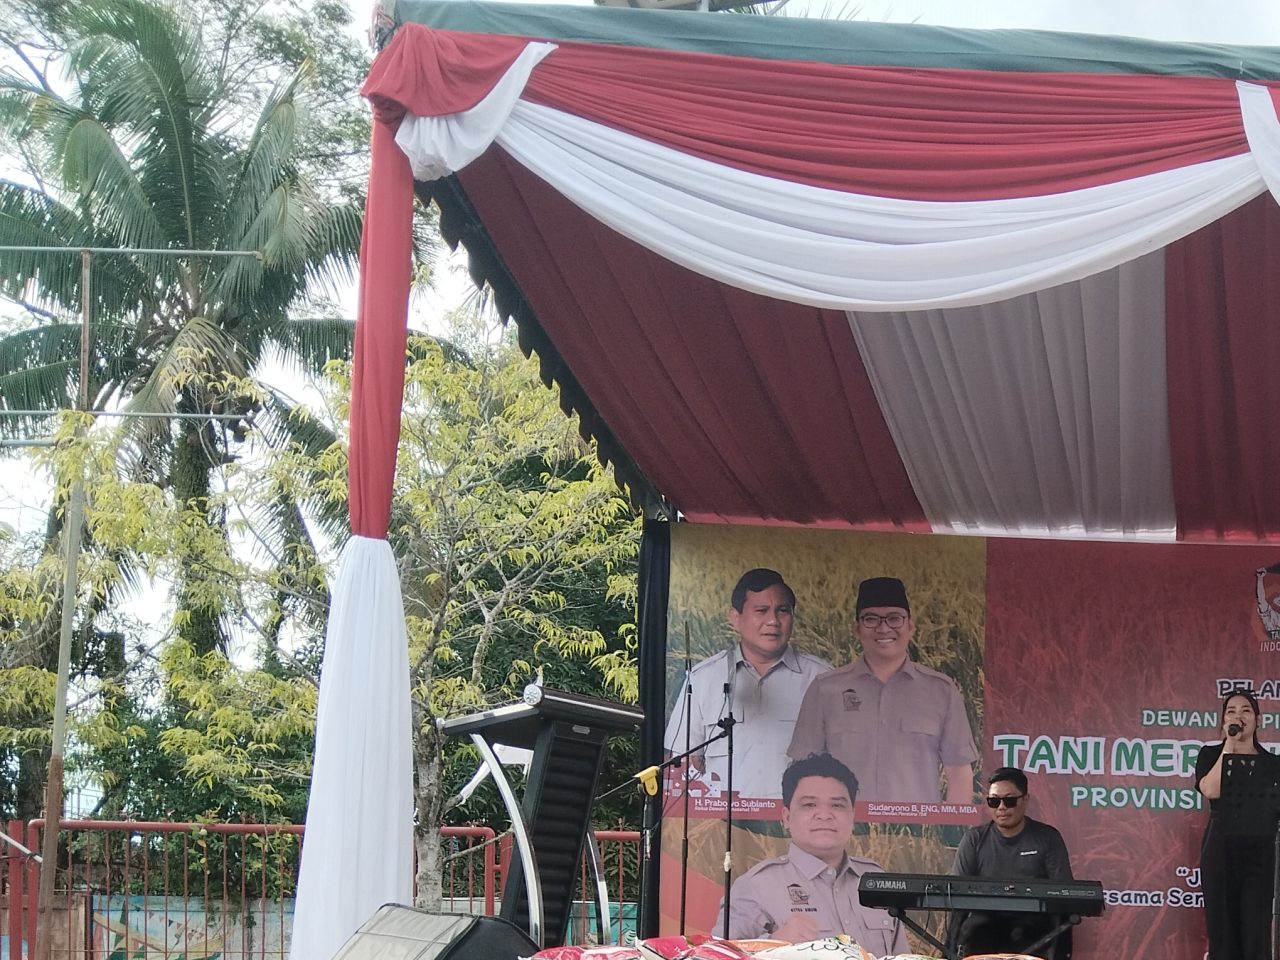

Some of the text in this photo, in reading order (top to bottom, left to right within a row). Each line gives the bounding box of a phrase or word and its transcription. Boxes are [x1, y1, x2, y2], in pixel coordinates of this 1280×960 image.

[1142, 709, 1217, 728] DEWAN
[994, 735, 1105, 775] TANI
[1071, 785, 1202, 810] PROVINSI
[868, 803, 910, 813] Sudaryono
[959, 806, 978, 814] MBA
[875, 880, 907, 890] YAMAHA
